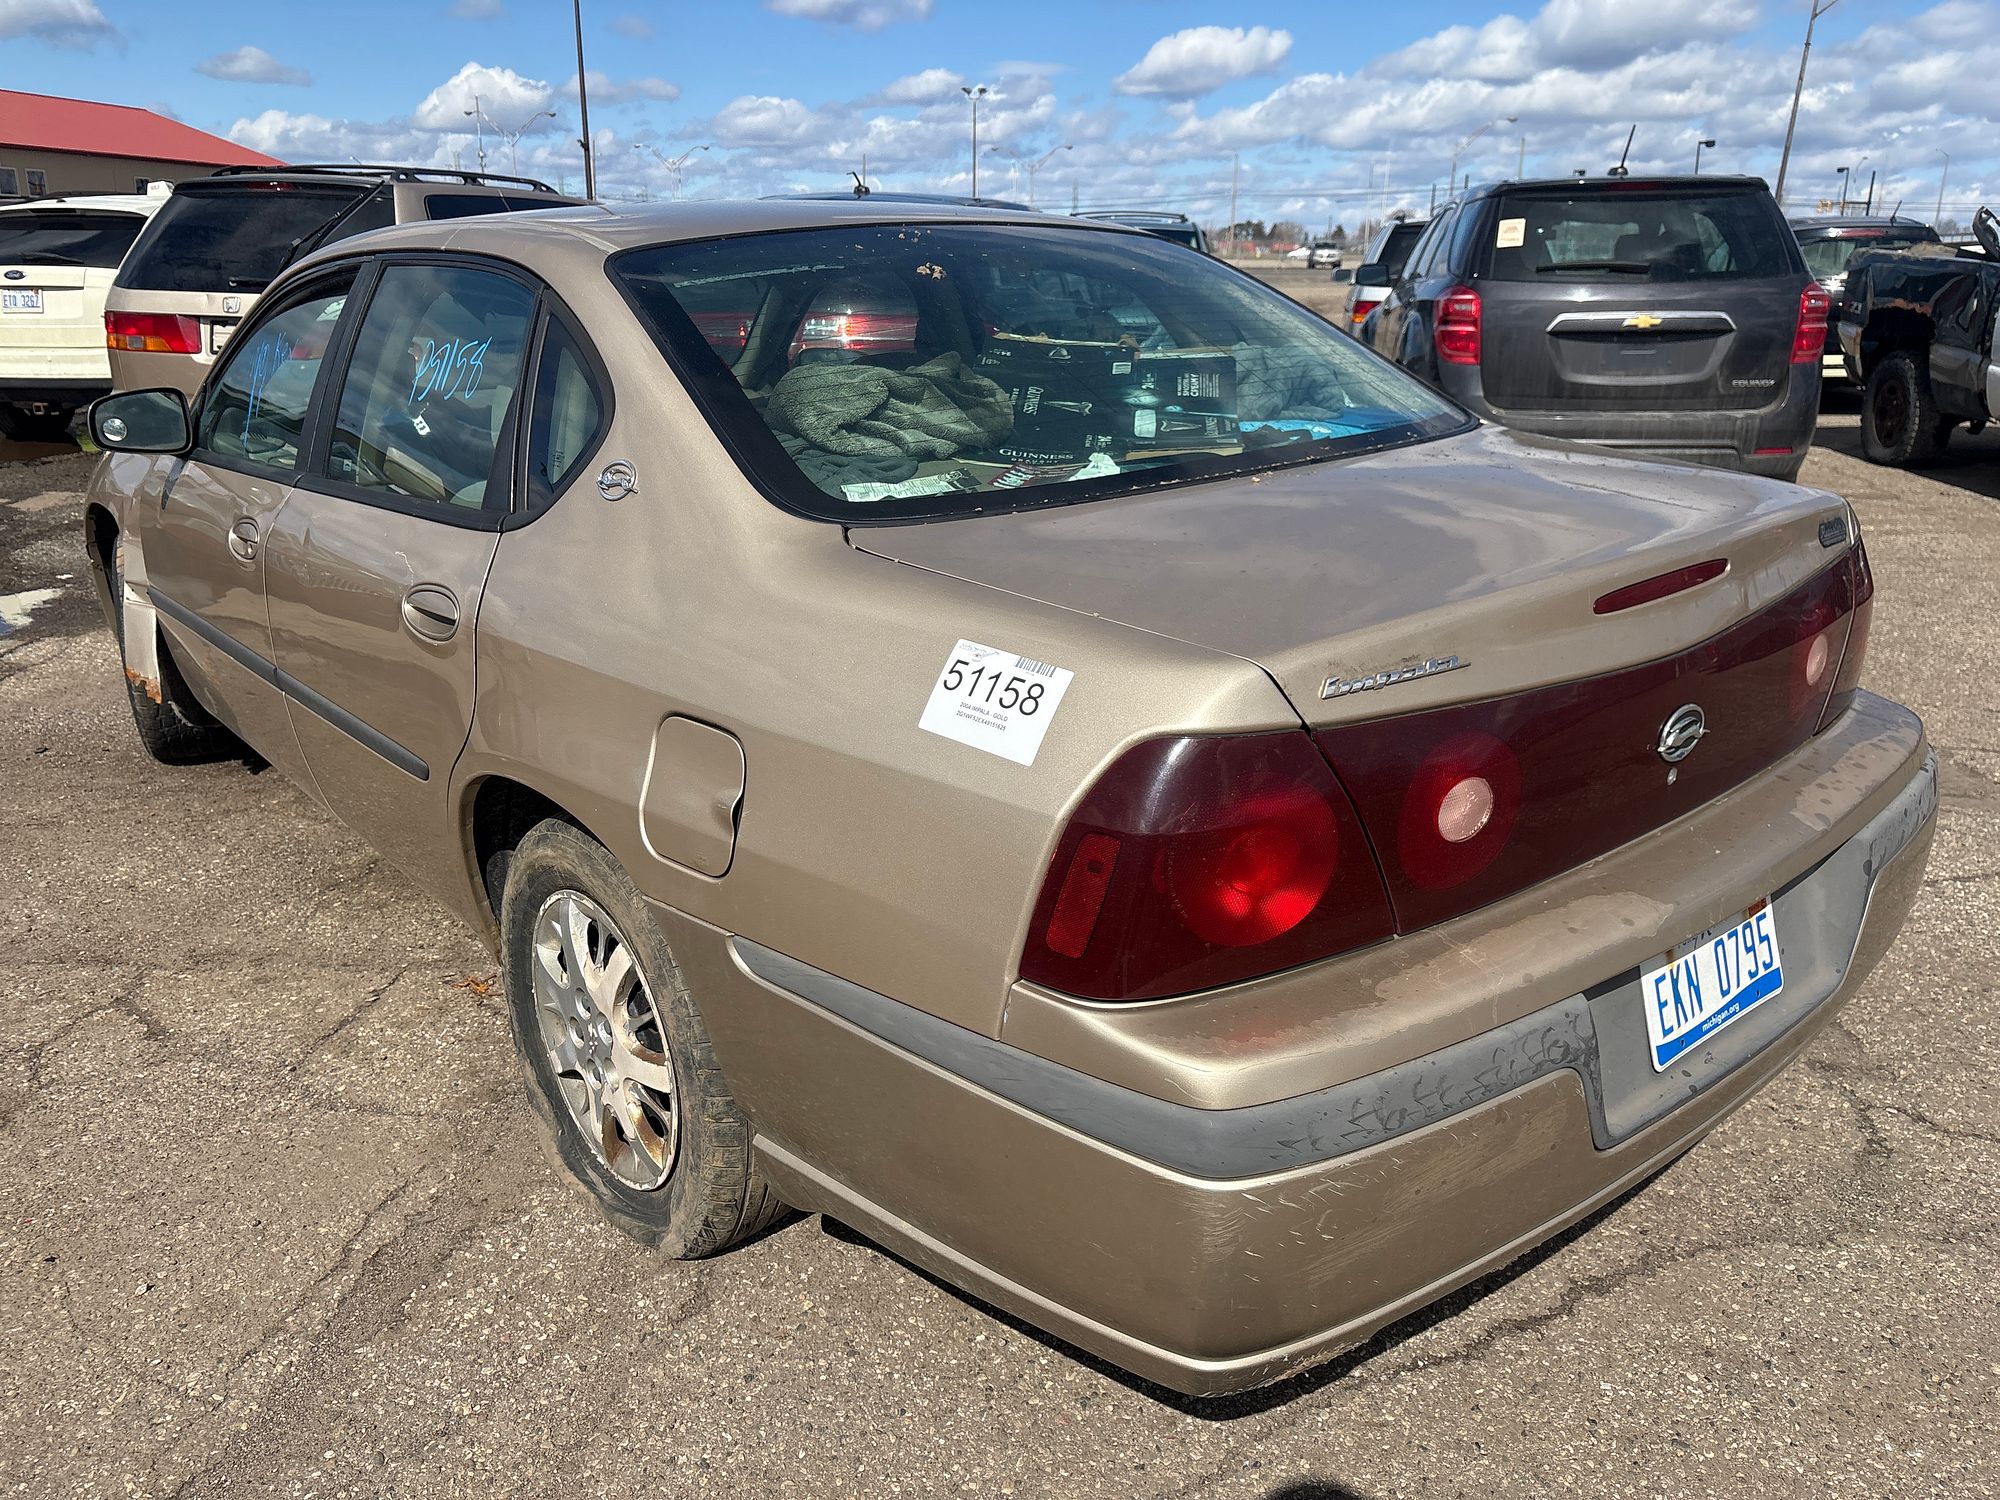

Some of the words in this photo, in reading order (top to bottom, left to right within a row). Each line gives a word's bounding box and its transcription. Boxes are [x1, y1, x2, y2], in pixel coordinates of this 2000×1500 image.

[21, 295, 39, 306] 3267
[999, 448, 1074, 460] GUINNESS
[943, 659, 1045, 716] 51158
[1318, 655, 1462, 700] Impala
[971, 706, 990, 716] IMPALA
[993, 712, 1008, 722] GOLD
[1654, 953, 1703, 1039] EKN
[1713, 911, 1774, 999] 0795
[1701, 1002, 1740, 1032] michigan.org
